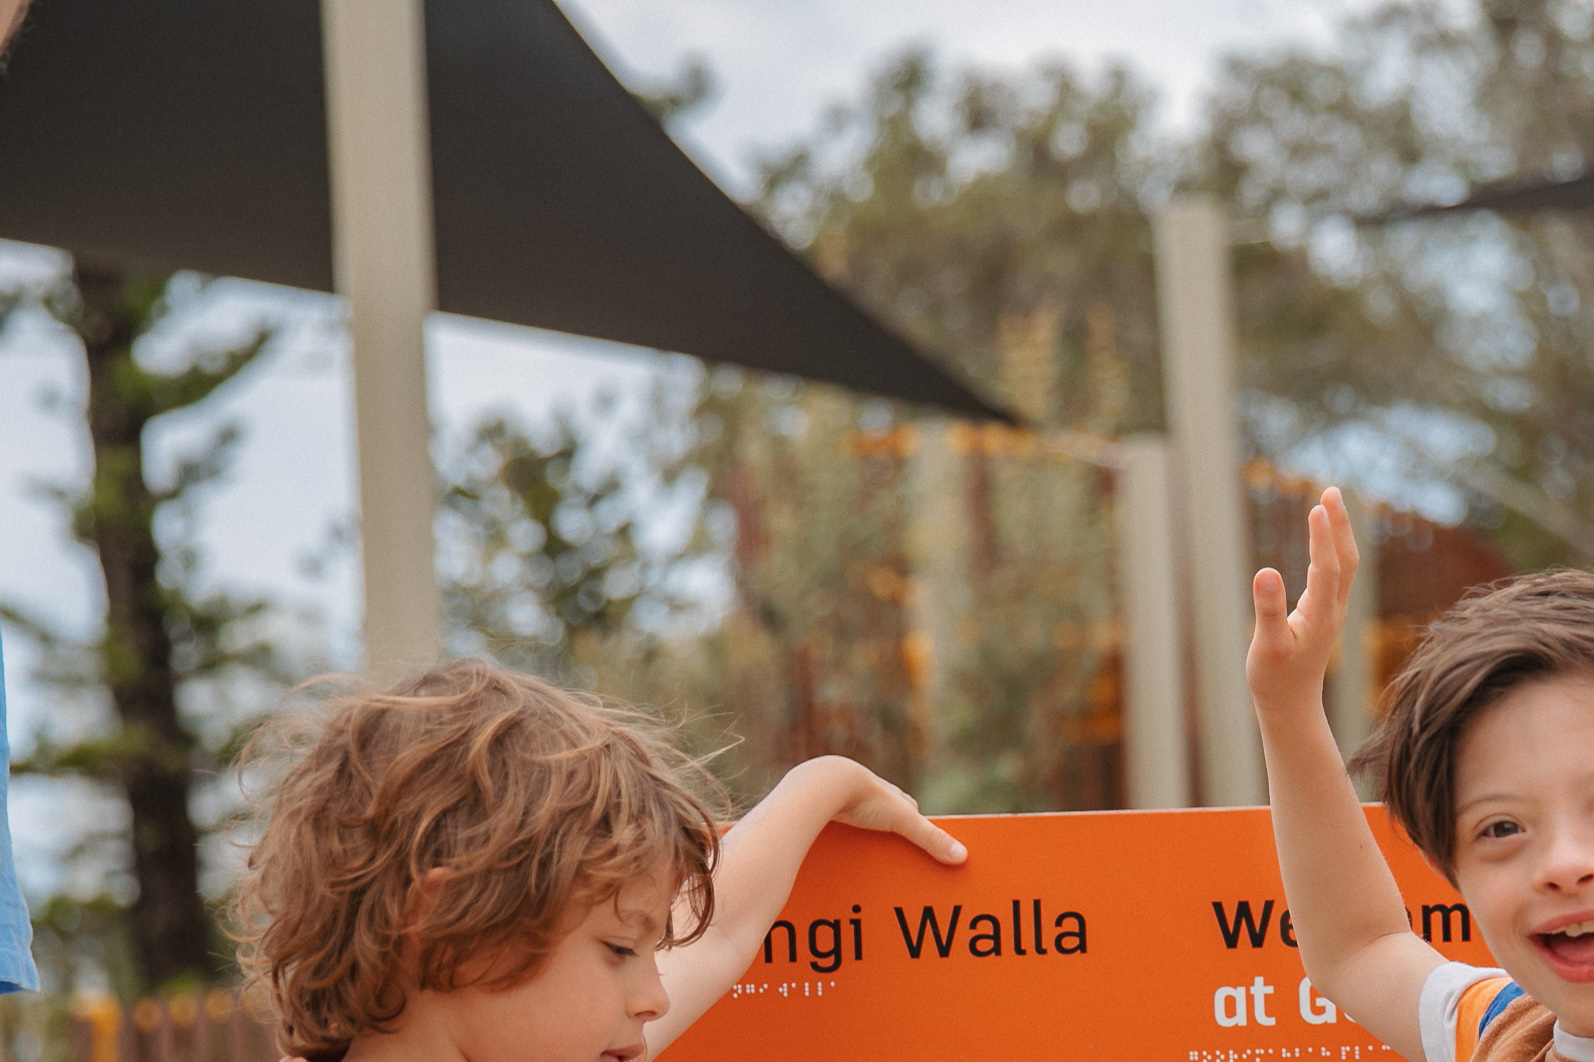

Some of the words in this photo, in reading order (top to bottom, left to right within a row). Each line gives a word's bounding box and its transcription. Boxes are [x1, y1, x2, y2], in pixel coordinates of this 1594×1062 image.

[893, 898, 1088, 959] Walla
[1213, 976, 1276, 1027] at
[1298, 976, 1357, 1025] G
